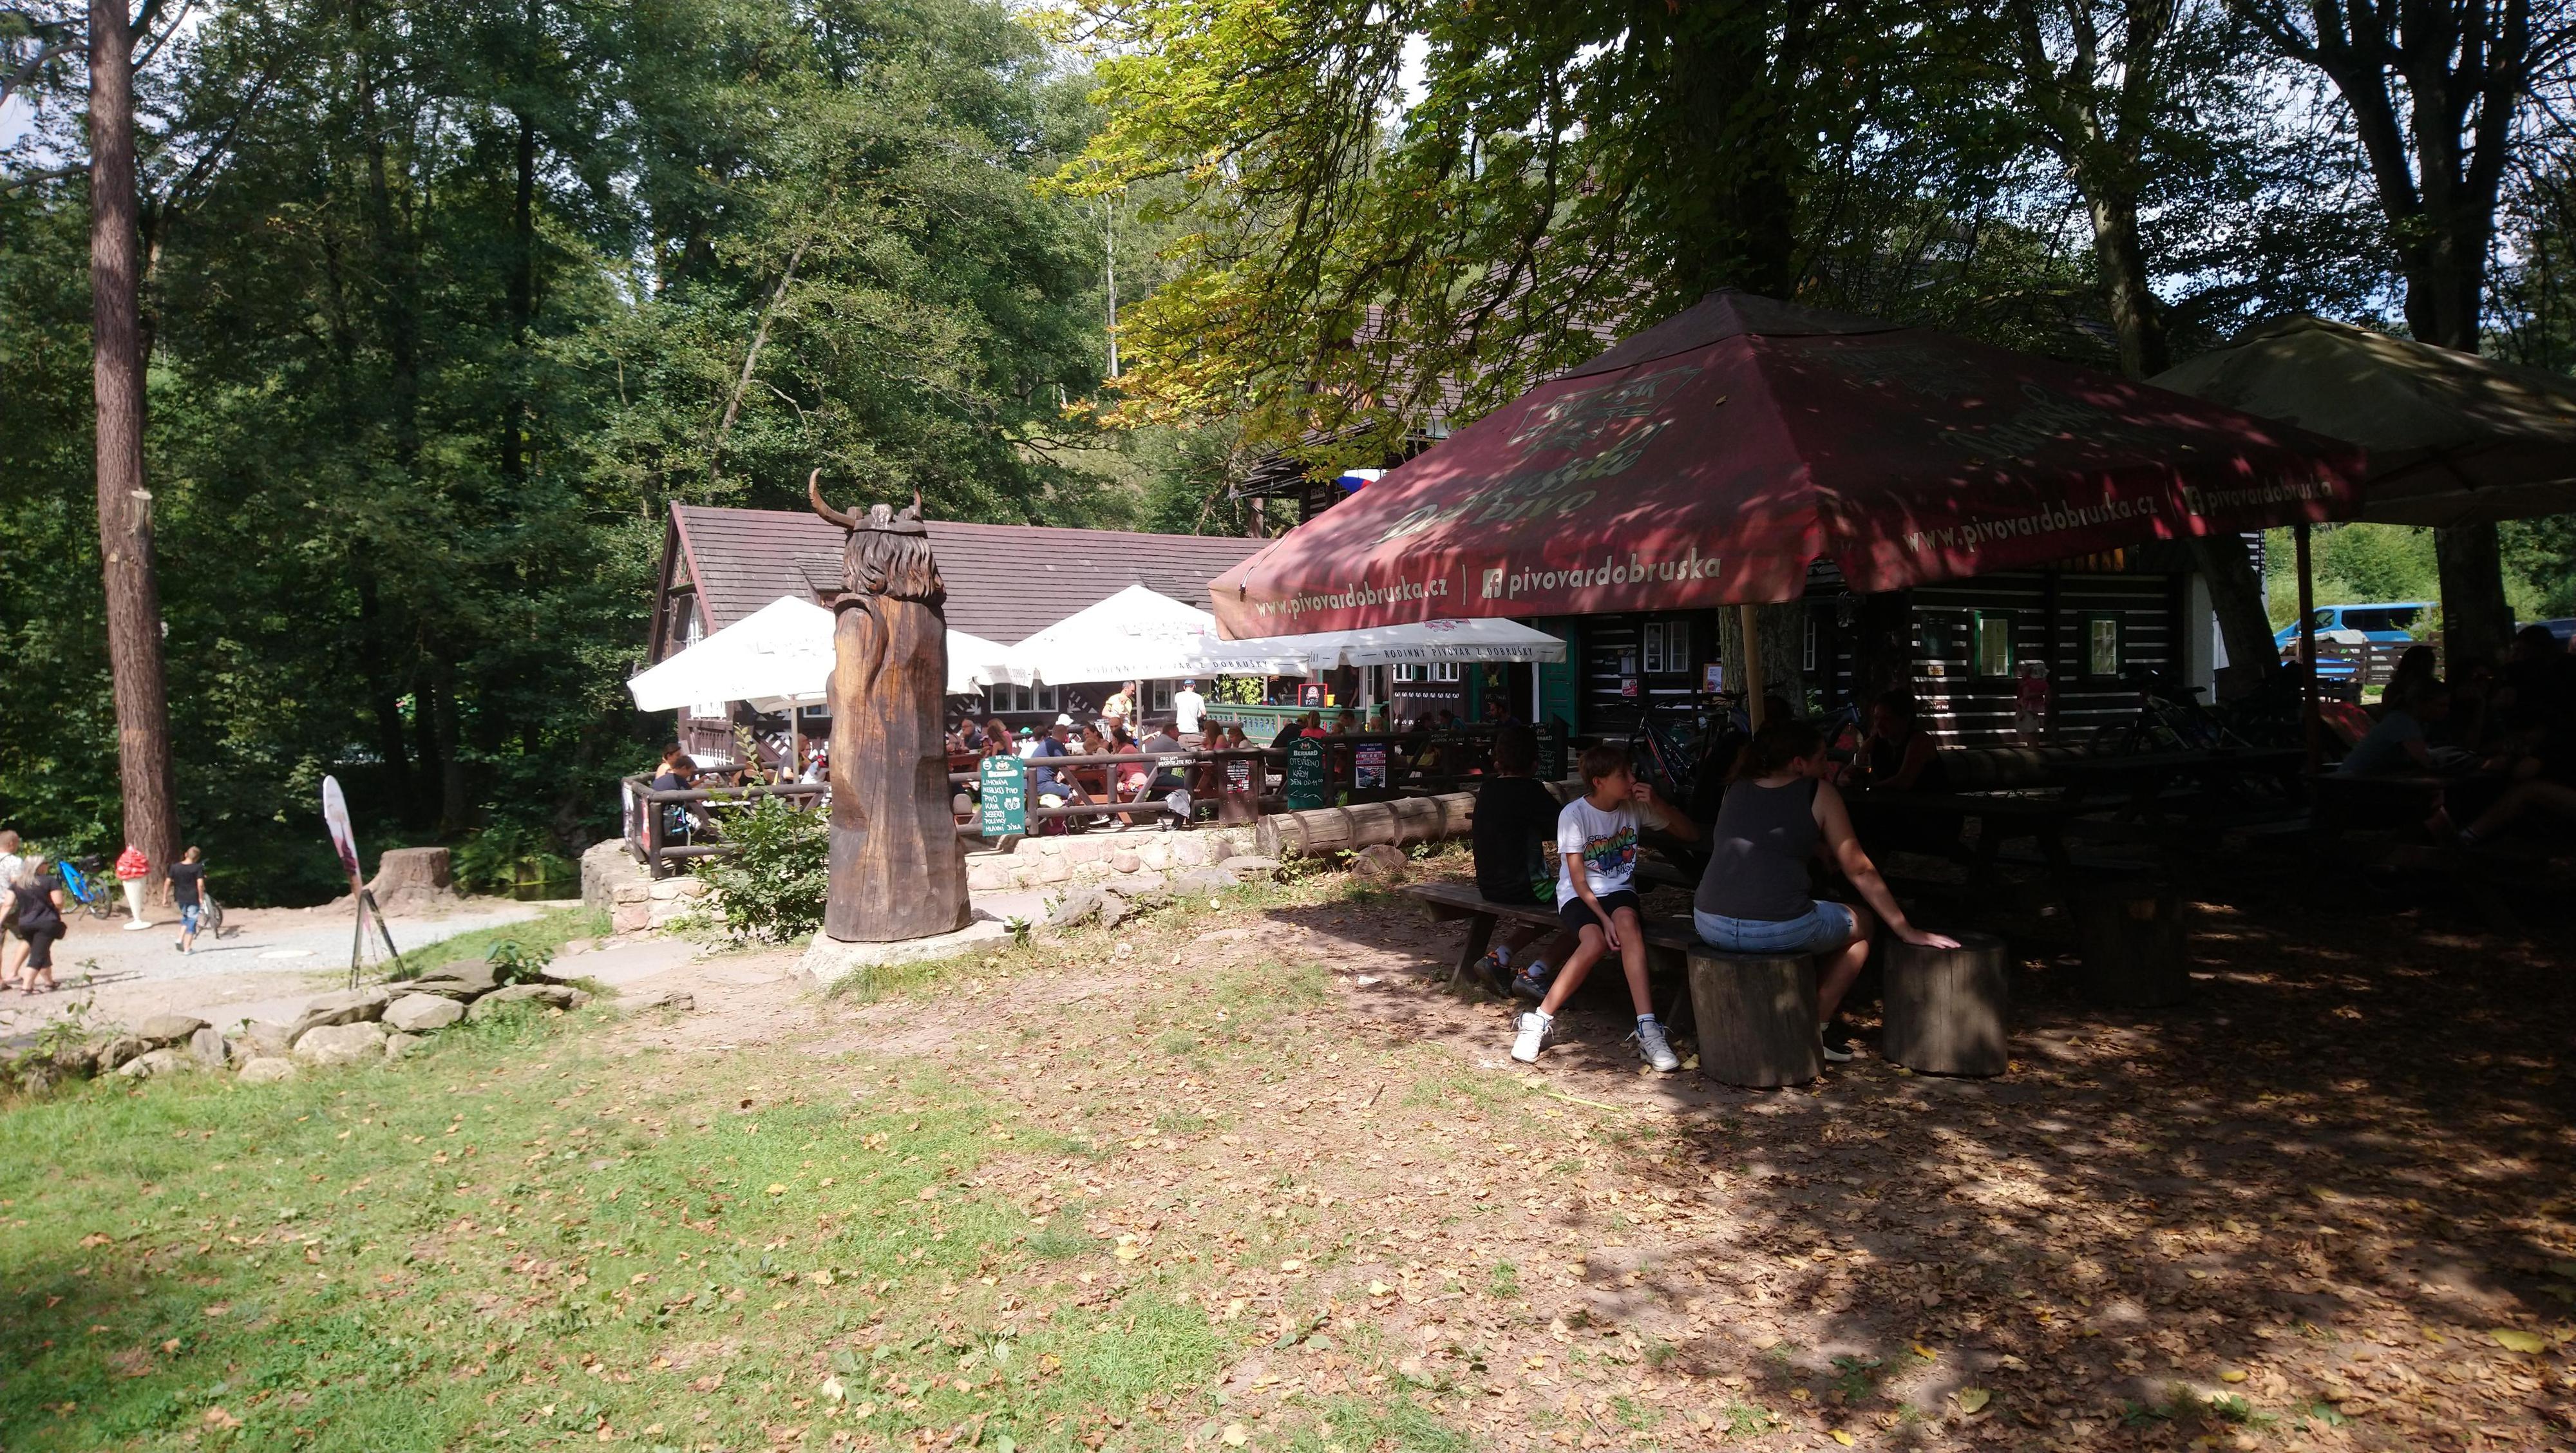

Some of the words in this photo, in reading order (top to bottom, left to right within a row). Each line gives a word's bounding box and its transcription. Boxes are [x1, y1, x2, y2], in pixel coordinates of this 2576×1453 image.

[1903, 491, 2158, 553] www.pivovardobruska.cz
[1509, 547, 1721, 600] pivovardobruska
[1255, 575, 1448, 620] www.pivovardobruska.cz
[1384, 647, 1425, 658] RODINNÝ
[1432, 647, 1471, 657] PIVOVAR
[1476, 647, 1481, 656] Z
[1487, 645, 1533, 656] DOBRUŠKY
[1213, 660, 1268, 669] DOBRUŠKY
[1289, 756, 1320, 768] OTEVŘENO
[1293, 765, 1309, 778] KAŽDÝ
